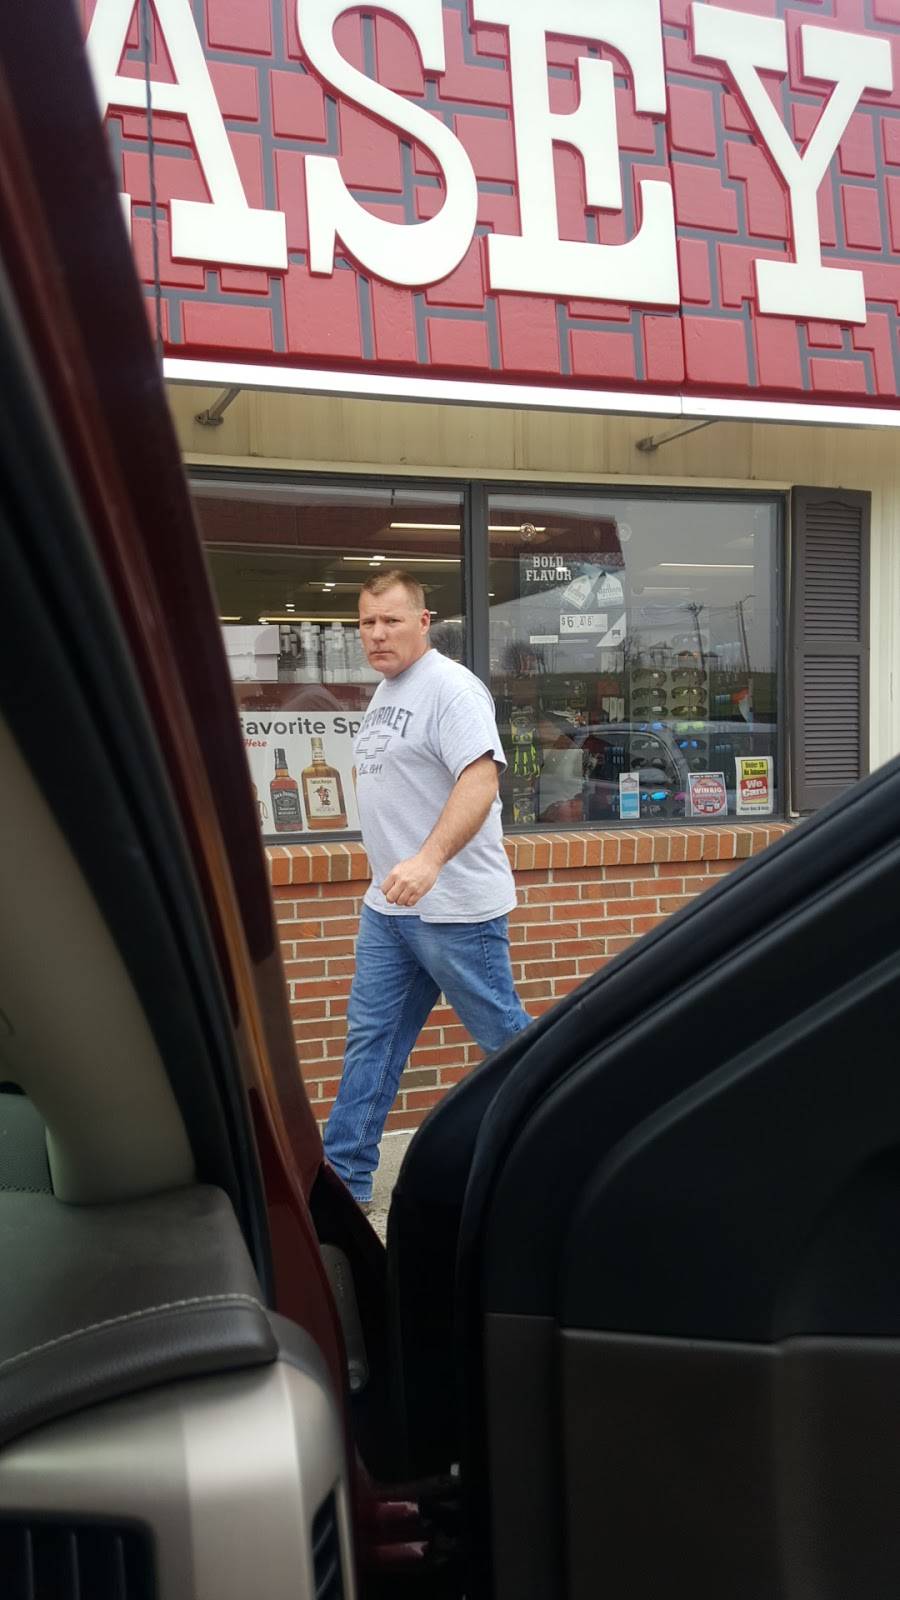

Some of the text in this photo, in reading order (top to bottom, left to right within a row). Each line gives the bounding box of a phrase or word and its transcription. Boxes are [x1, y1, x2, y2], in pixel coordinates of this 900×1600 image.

[533, 556, 564, 568] BOLD
[526, 569, 572, 581] FLAVOR
[333, 717, 364, 738] Sp
[746, 780, 763, 789] We
[742, 786, 768, 798] Card
